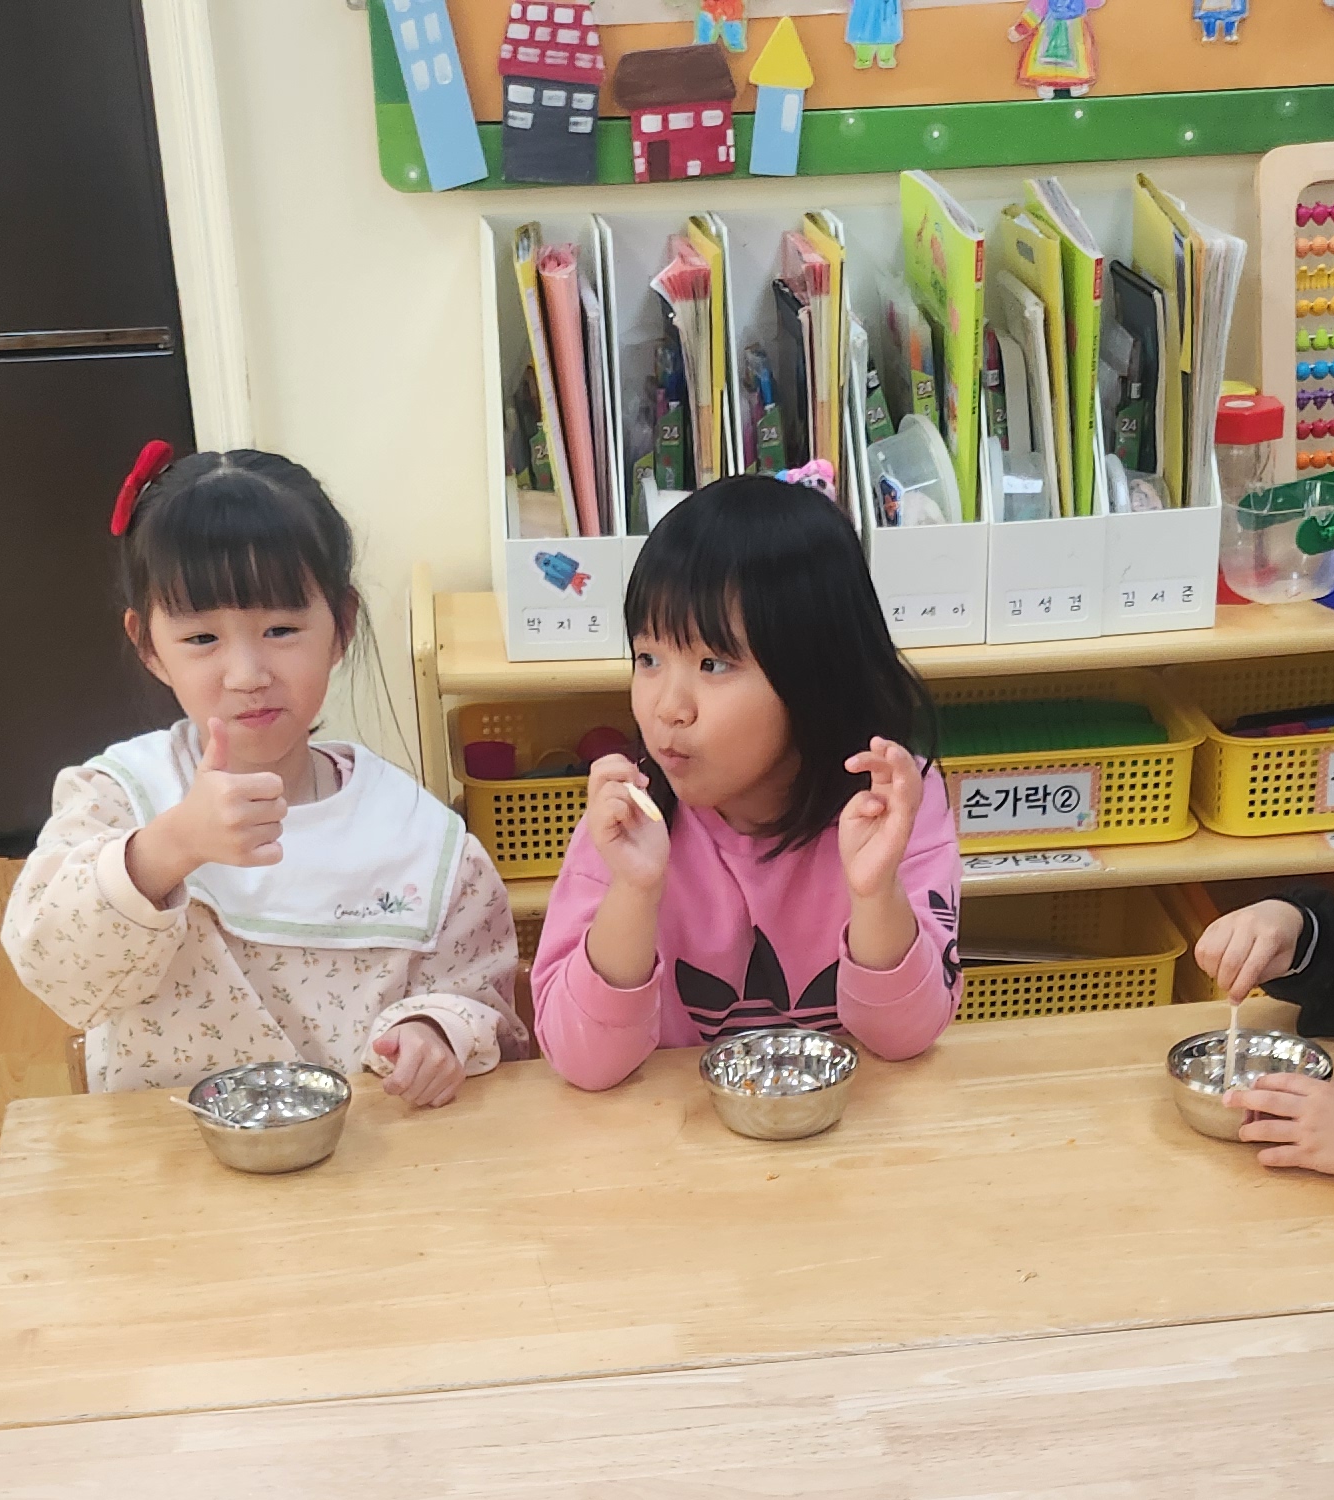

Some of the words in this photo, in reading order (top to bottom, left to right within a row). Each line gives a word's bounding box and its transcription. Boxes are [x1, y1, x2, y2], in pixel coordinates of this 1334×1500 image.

[1121, 418, 1137, 431] 24
[662, 426, 679, 440] 24
[760, 427, 778, 441] 24
